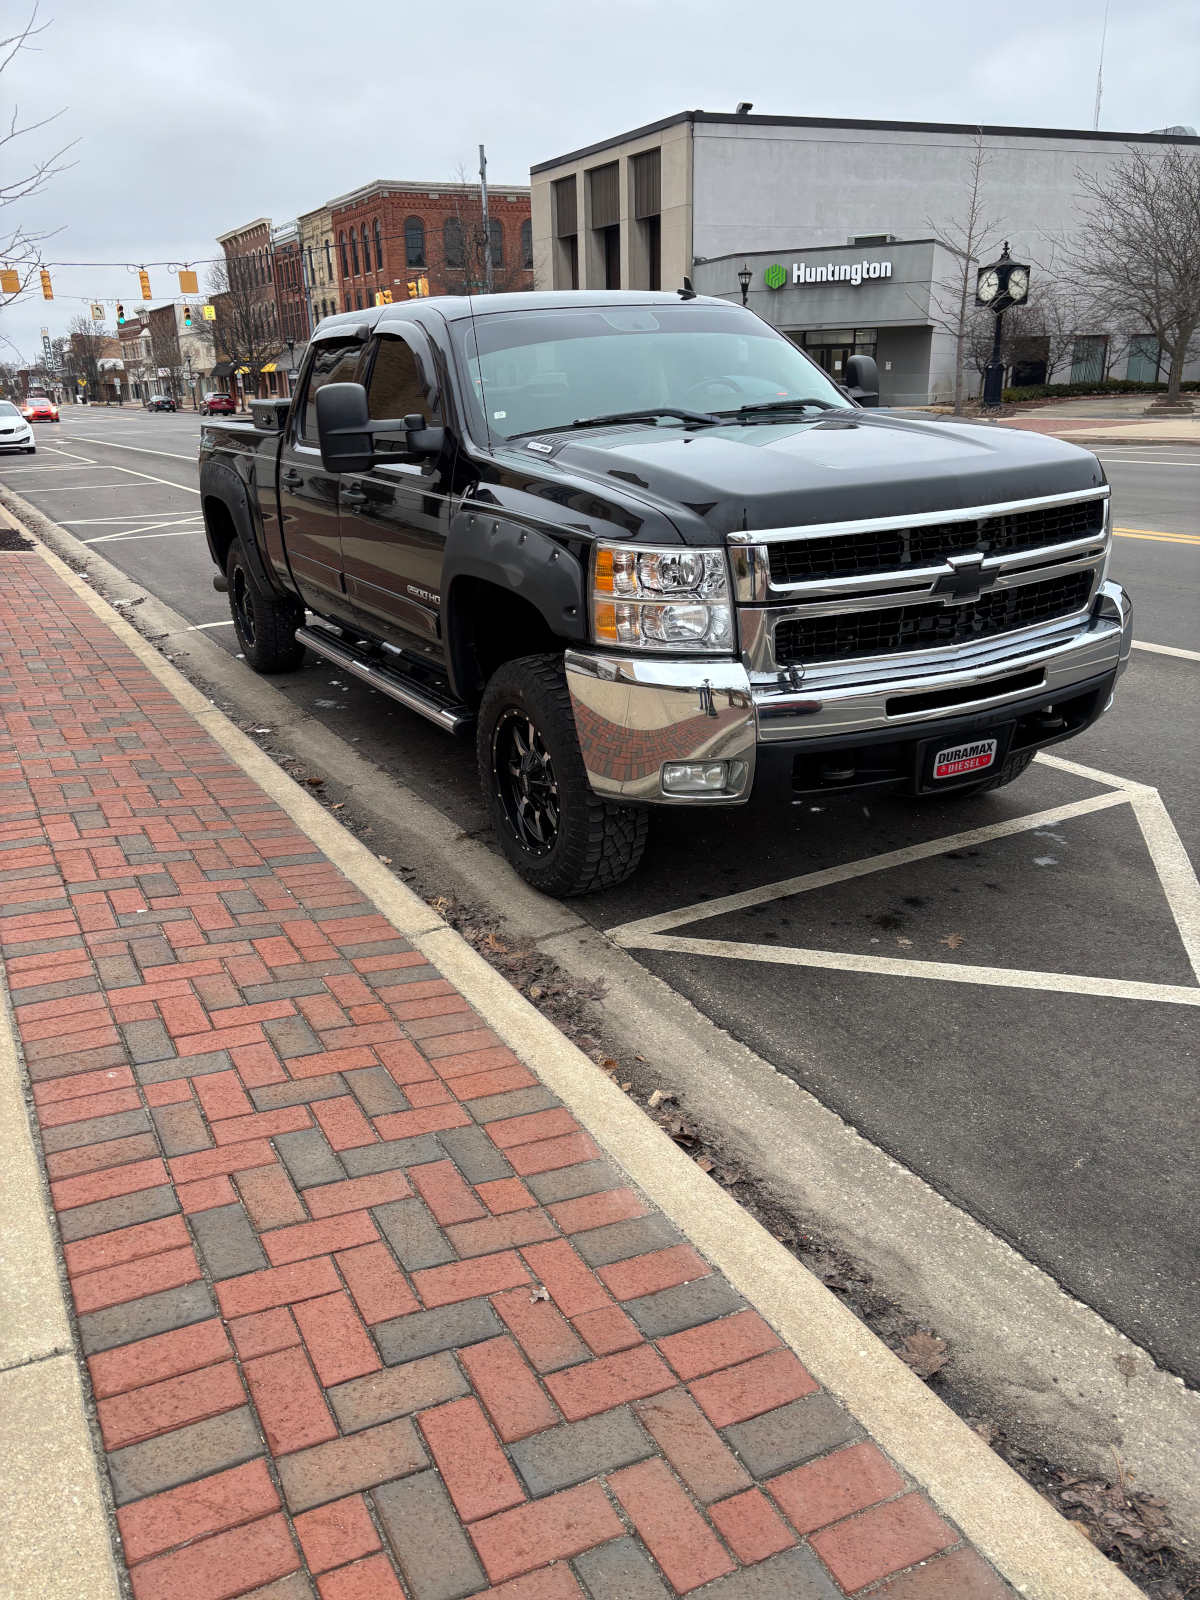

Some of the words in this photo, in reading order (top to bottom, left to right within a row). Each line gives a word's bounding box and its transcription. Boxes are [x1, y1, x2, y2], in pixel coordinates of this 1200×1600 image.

[792, 260, 892, 286] Huntington
[43, 337, 53, 368] STRAND
[938, 741, 995, 765] DURAMAX
[948, 758, 981, 773] DIESEL
